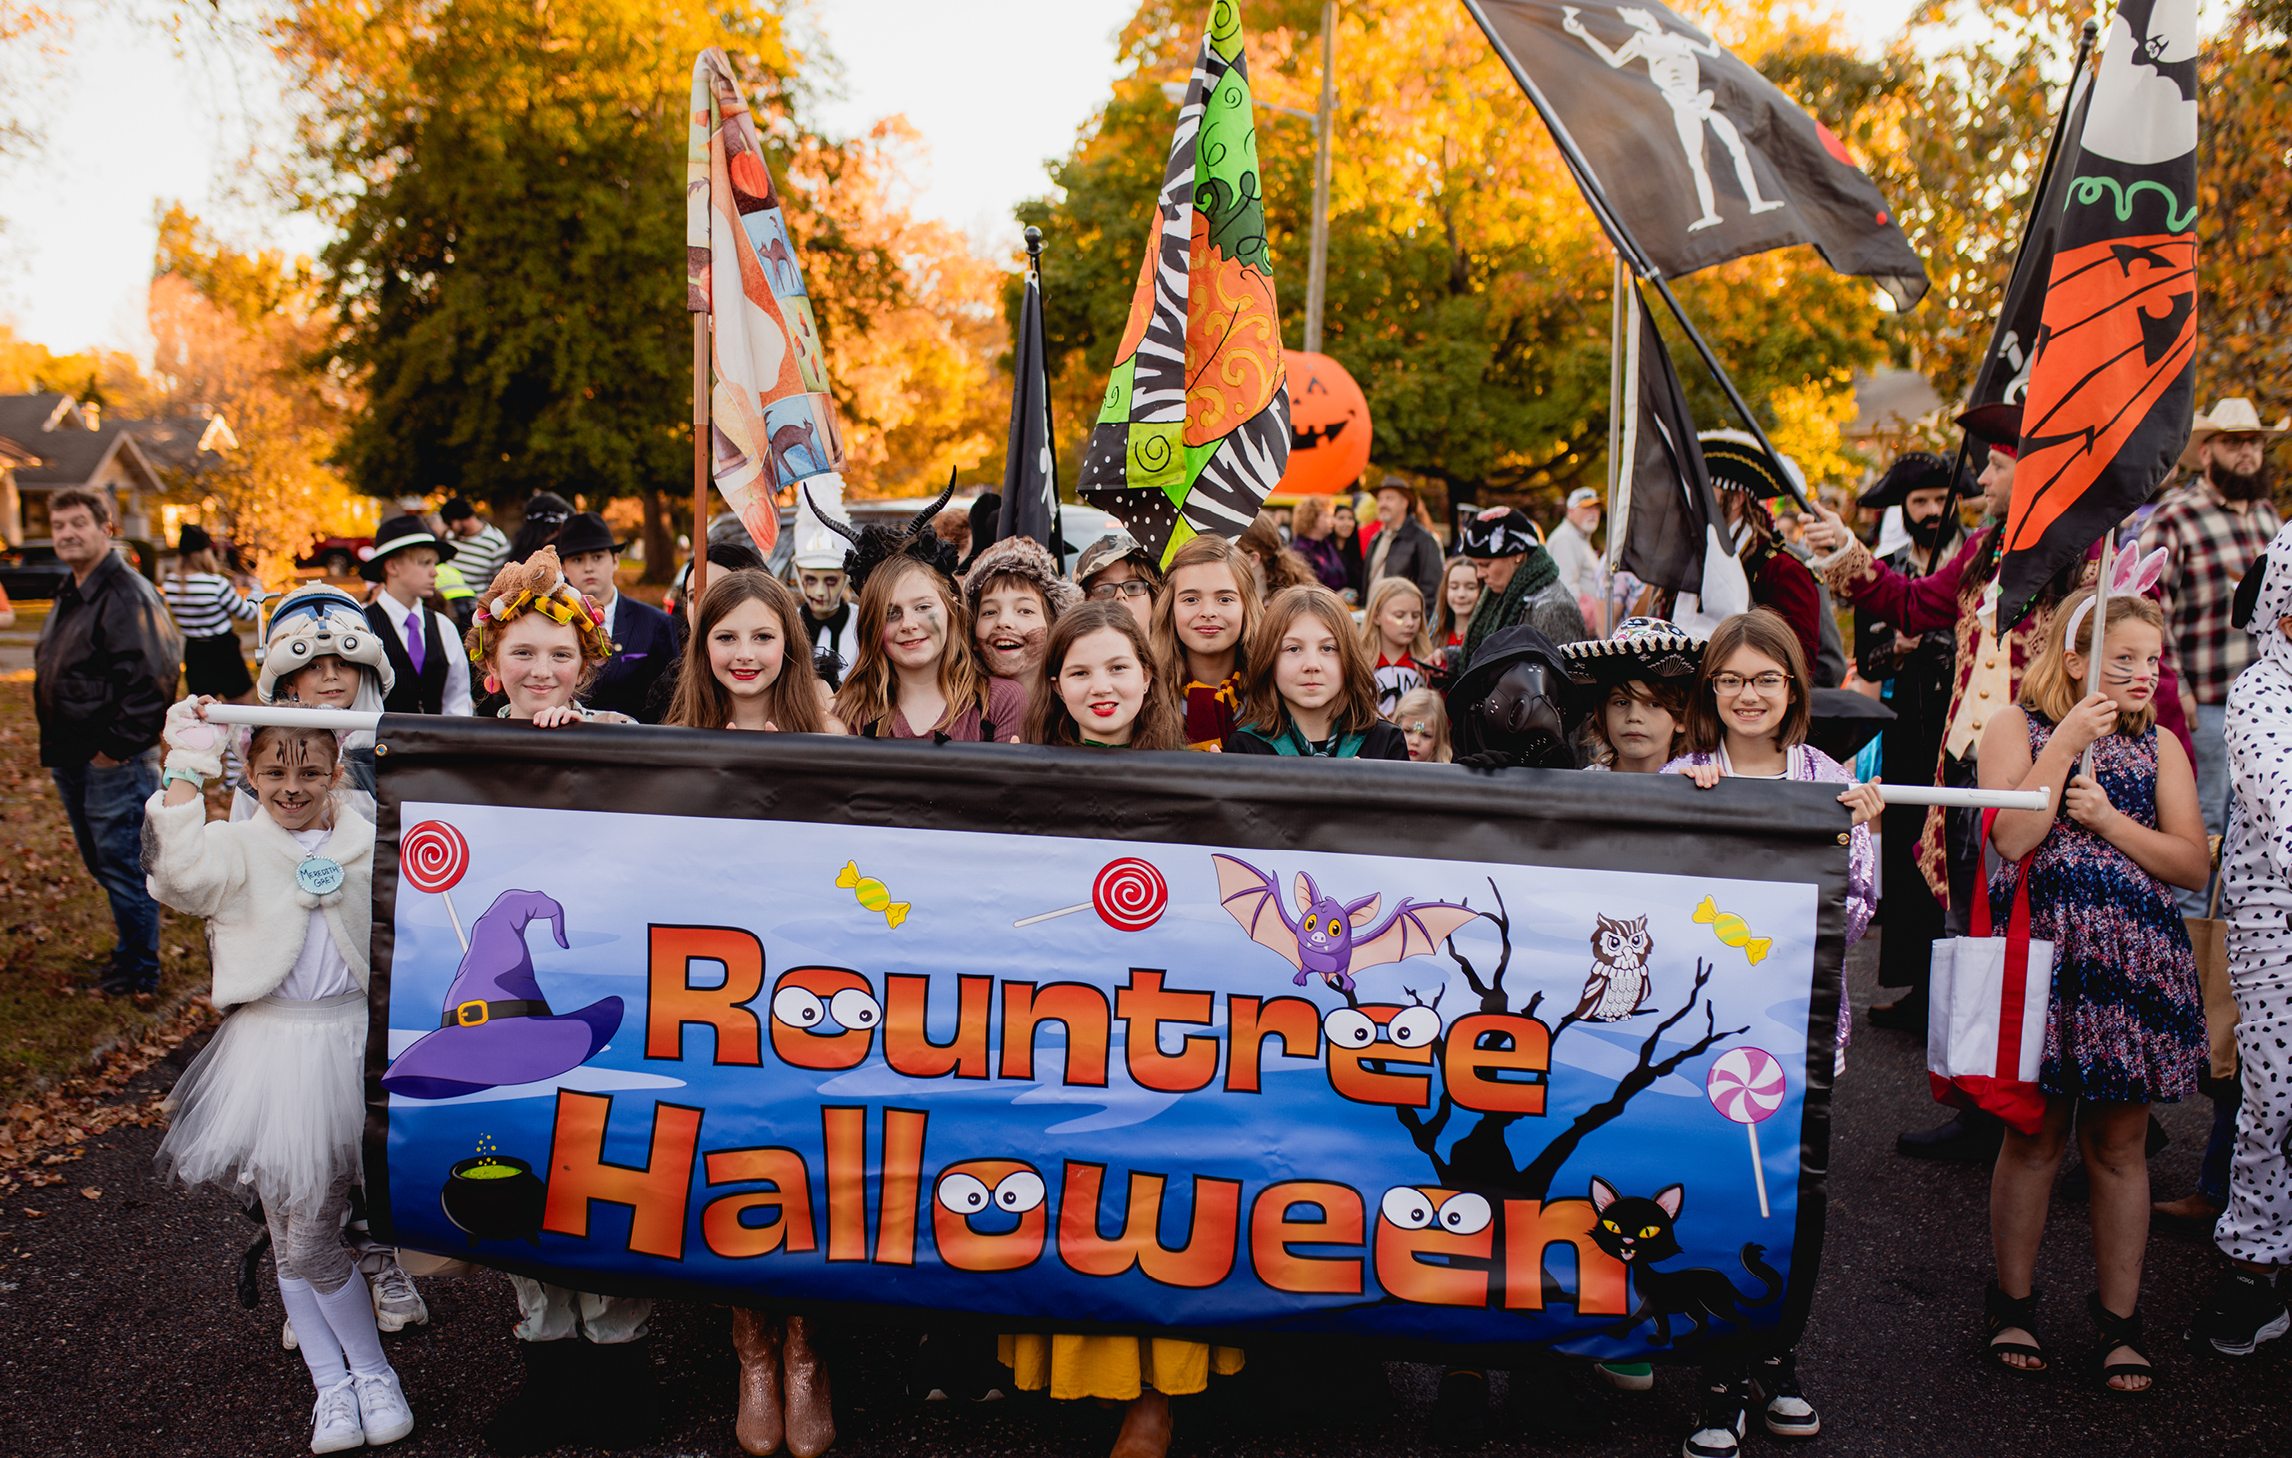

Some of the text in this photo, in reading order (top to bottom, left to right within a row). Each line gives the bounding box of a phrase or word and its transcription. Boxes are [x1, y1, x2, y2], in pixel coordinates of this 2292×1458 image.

[300, 866, 339, 881] MEREDITH
[314, 875, 336, 888] GREY
[645, 923, 1551, 1117] Rountree
[542, 1086, 1629, 1317] Halloween
[2236, 1275, 2256, 1286] HOKA
